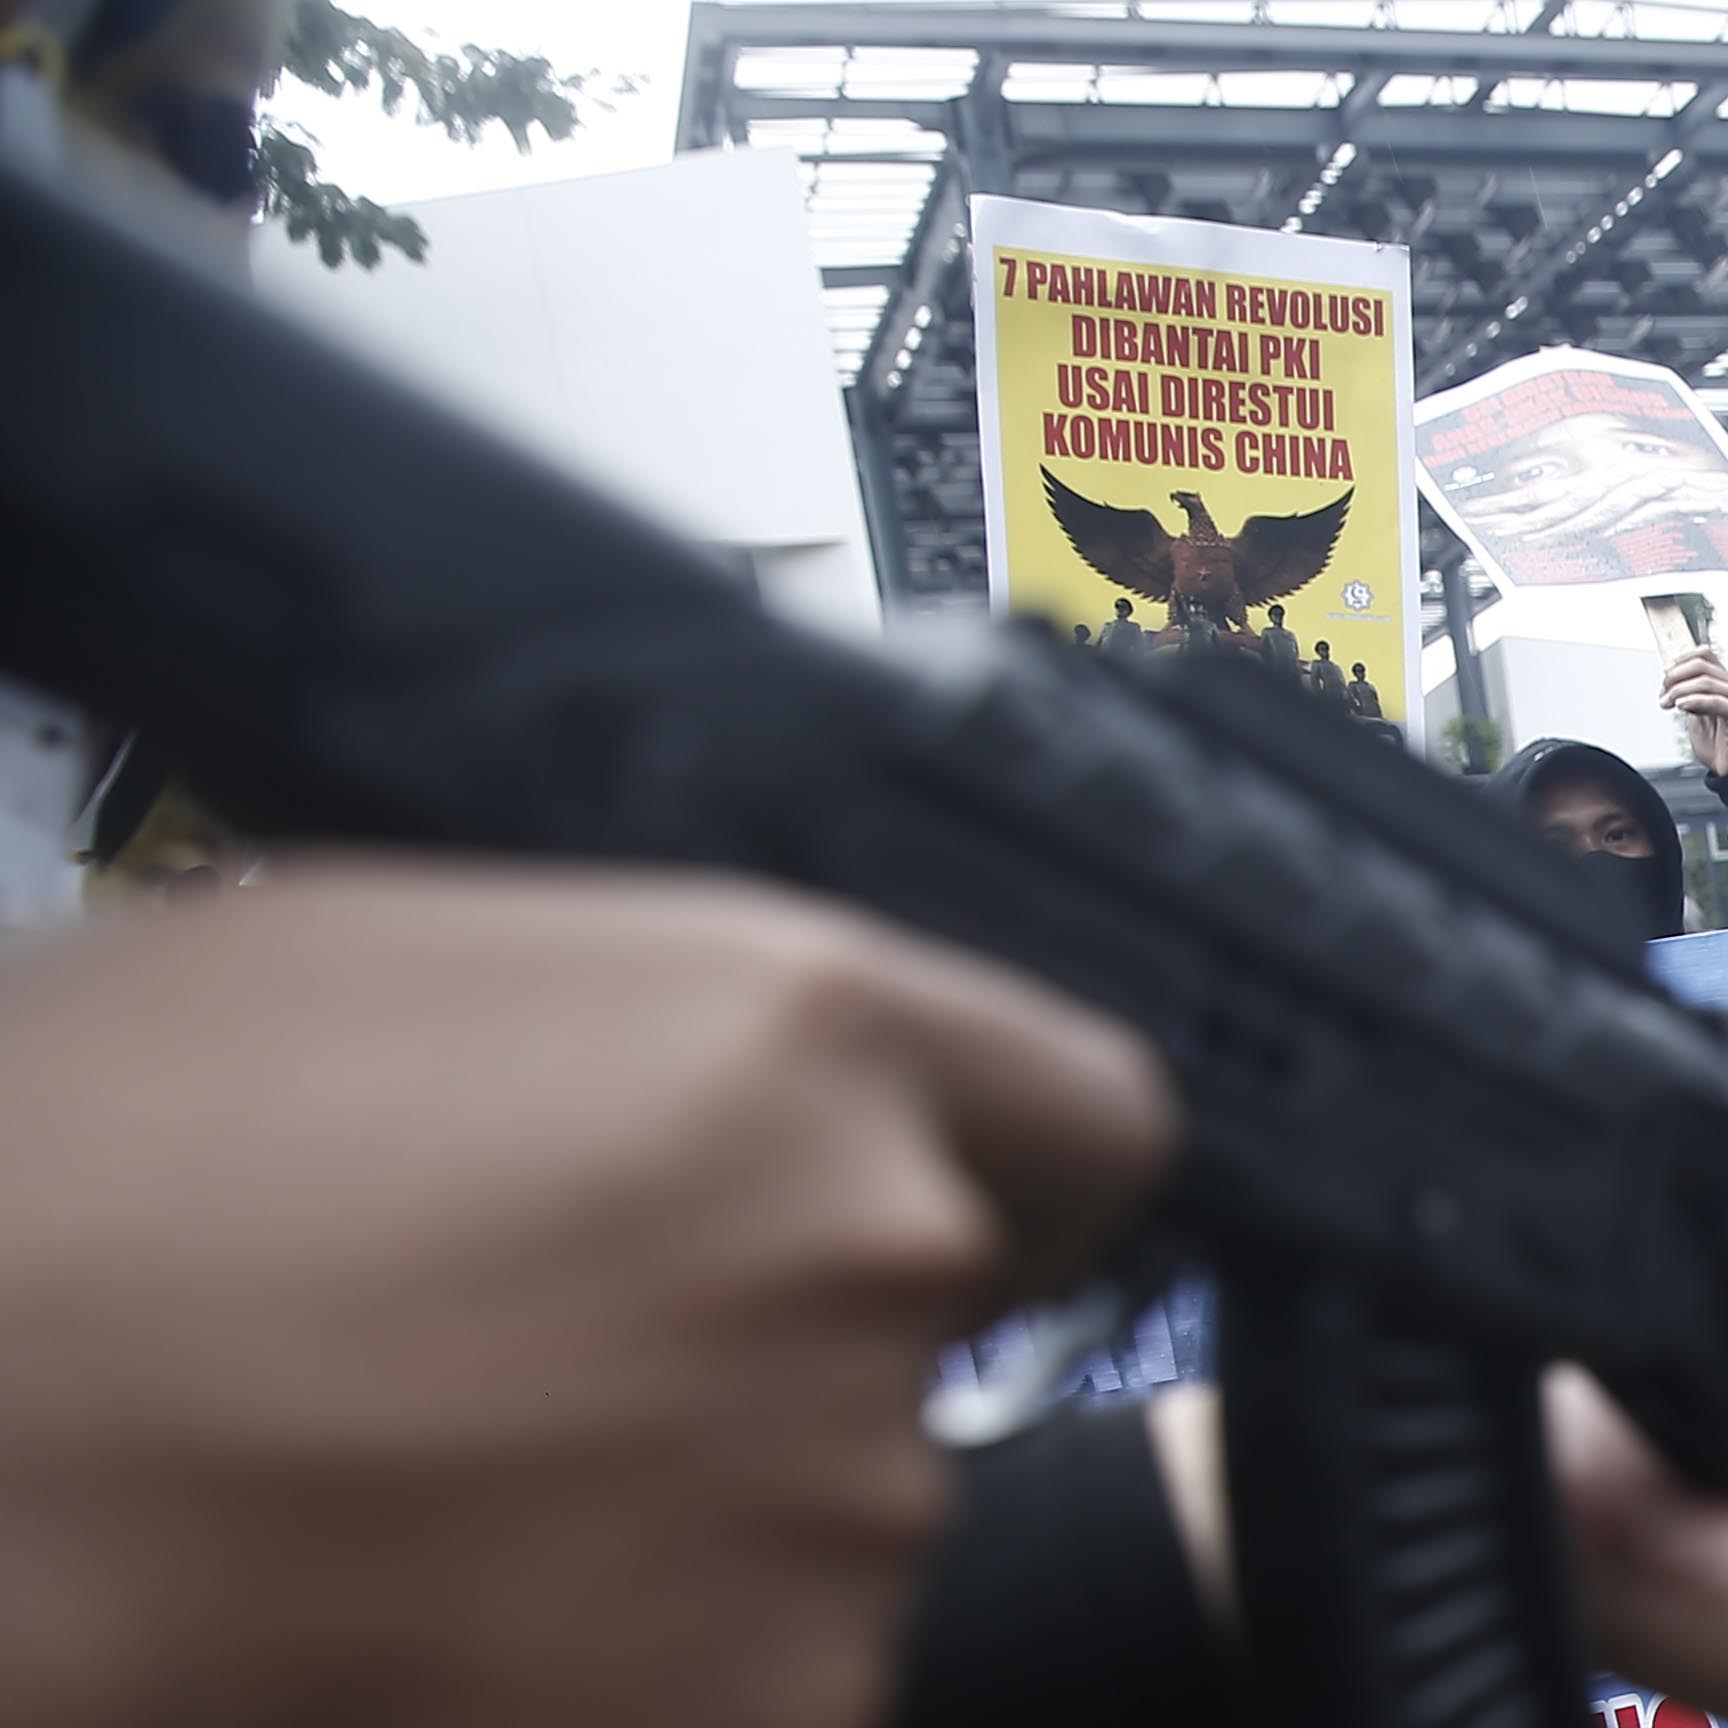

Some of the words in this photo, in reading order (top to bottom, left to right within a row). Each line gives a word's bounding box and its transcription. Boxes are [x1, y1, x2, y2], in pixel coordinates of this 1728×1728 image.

[1000, 257, 1016, 298] 7
[1026, 261, 1217, 319] PAHLAWAN
[1226, 284, 1386, 337] REVOLUSI
[1072, 314, 1250, 375] DIBANTAI
[1260, 333, 1321, 380] PKI
[1057, 364, 1151, 416] USAI
[1161, 377, 1335, 431] DIRESTUI
[1042, 414, 1226, 470] KOMUNIS
[1235, 432, 1354, 480] CHINA
